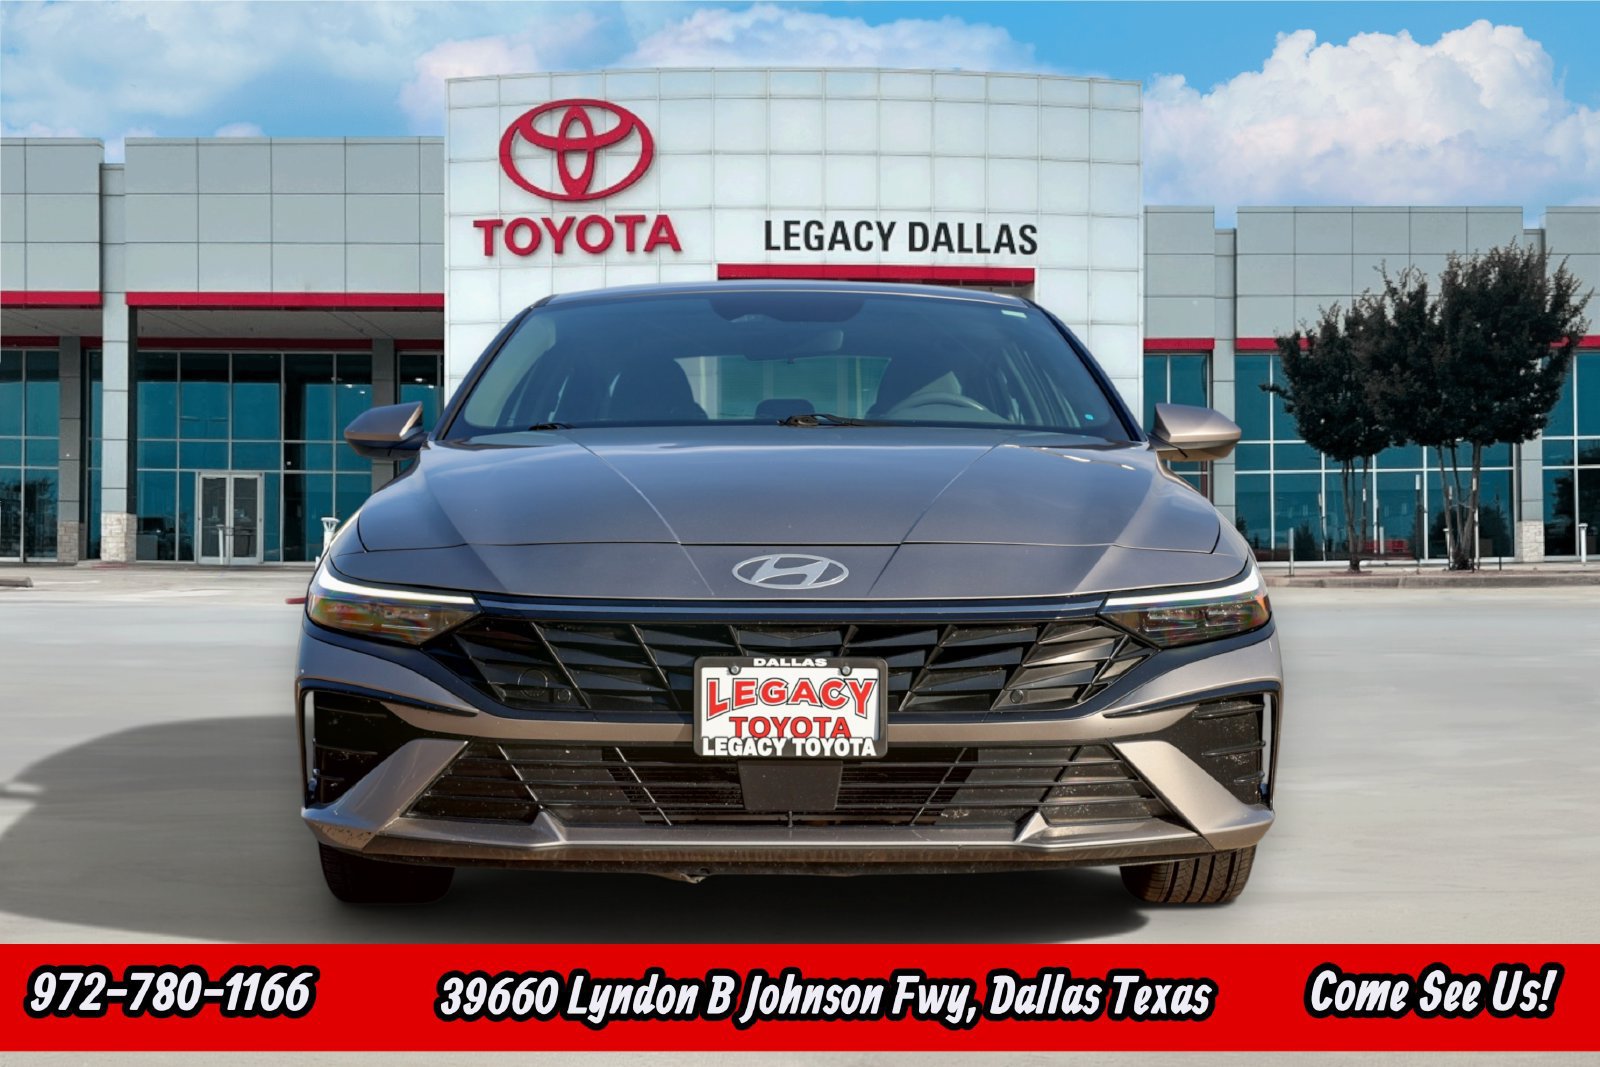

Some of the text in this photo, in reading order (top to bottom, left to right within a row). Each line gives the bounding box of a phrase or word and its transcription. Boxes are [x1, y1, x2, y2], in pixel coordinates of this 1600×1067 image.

[473, 214, 682, 257] TOYOTA
[764, 219, 1038, 255] LEGACY DALLAS
[753, 658, 828, 667] DALLAS
[706, 677, 878, 721] LEGACY
[728, 716, 852, 739] TOYOTA
[702, 736, 877, 757] LEGACY TOYOTA
